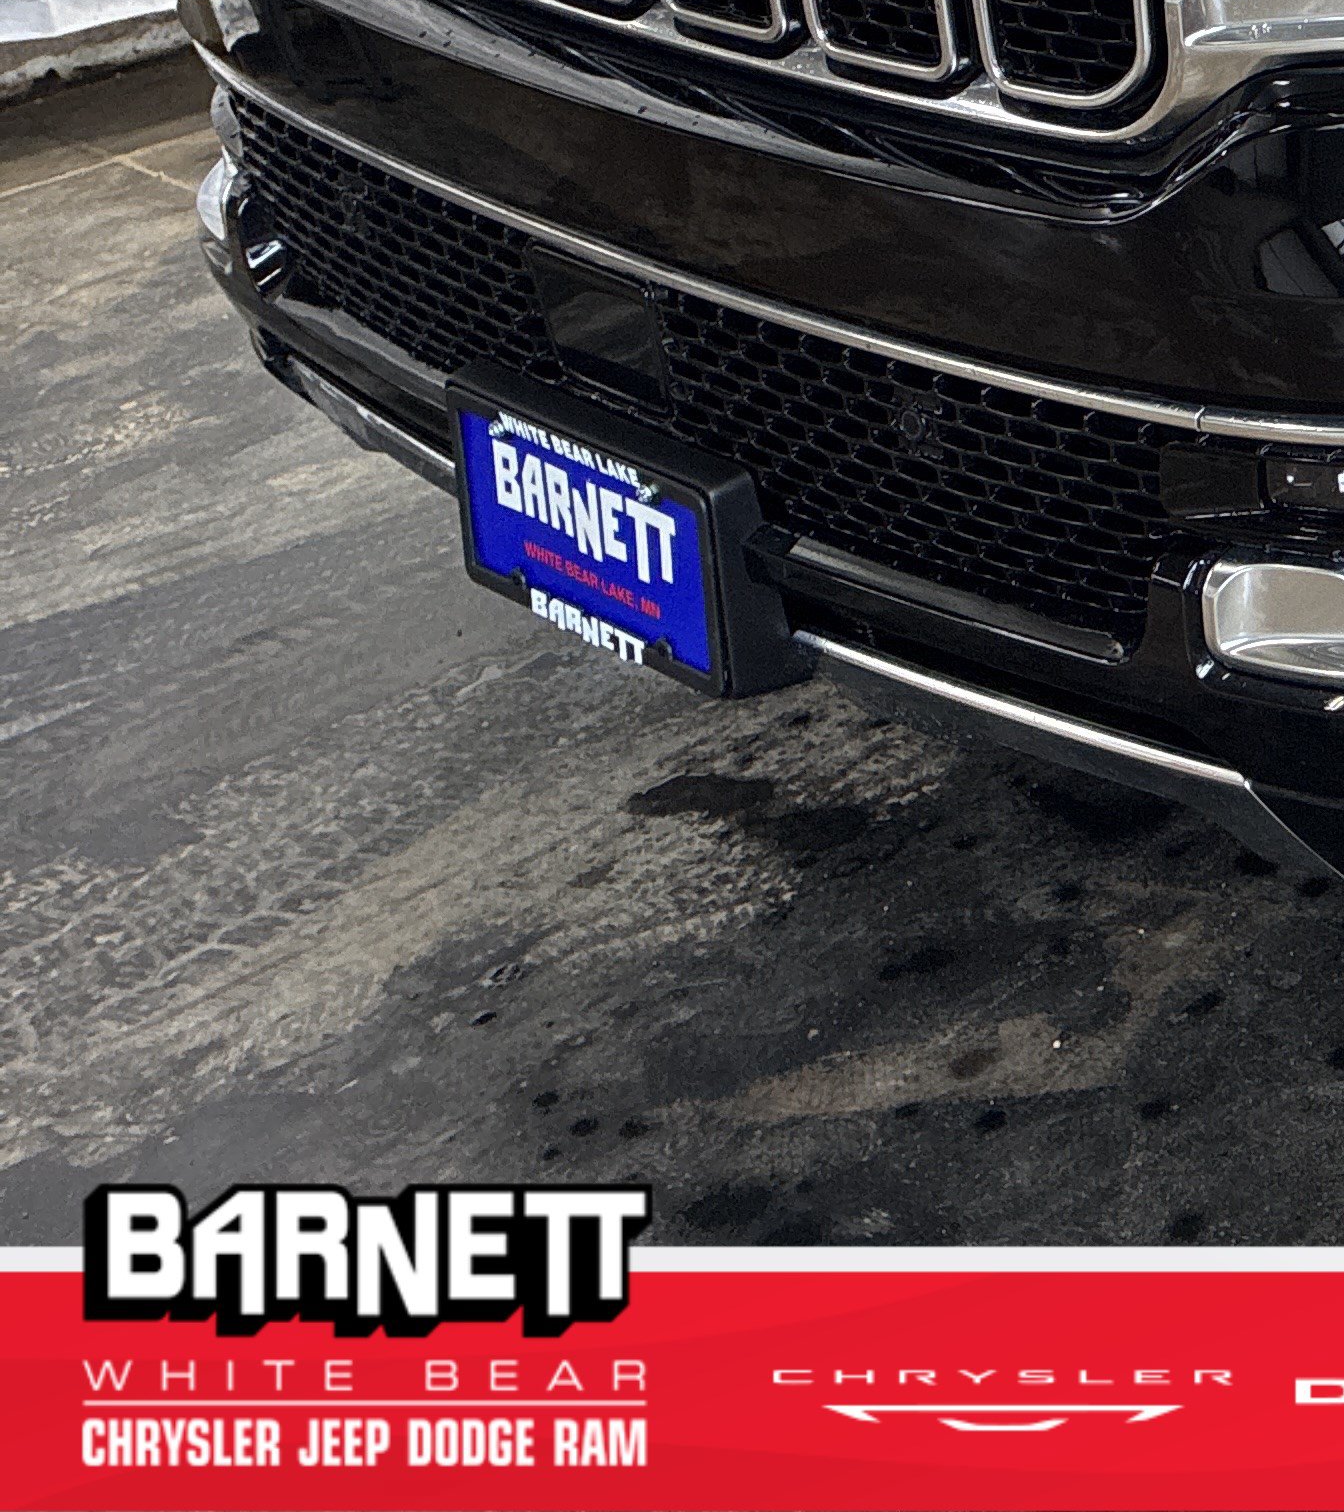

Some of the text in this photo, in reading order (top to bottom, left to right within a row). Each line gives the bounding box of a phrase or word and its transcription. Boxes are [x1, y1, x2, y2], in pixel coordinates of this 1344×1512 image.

[498, 411, 641, 489] WHITE BEAR LAKE
[491, 438, 677, 585] BARNETT
[524, 539, 565, 573] WHITE
[564, 559, 600, 589] BEAR
[640, 596, 662, 620] MN
[530, 587, 646, 665] BARNETT
